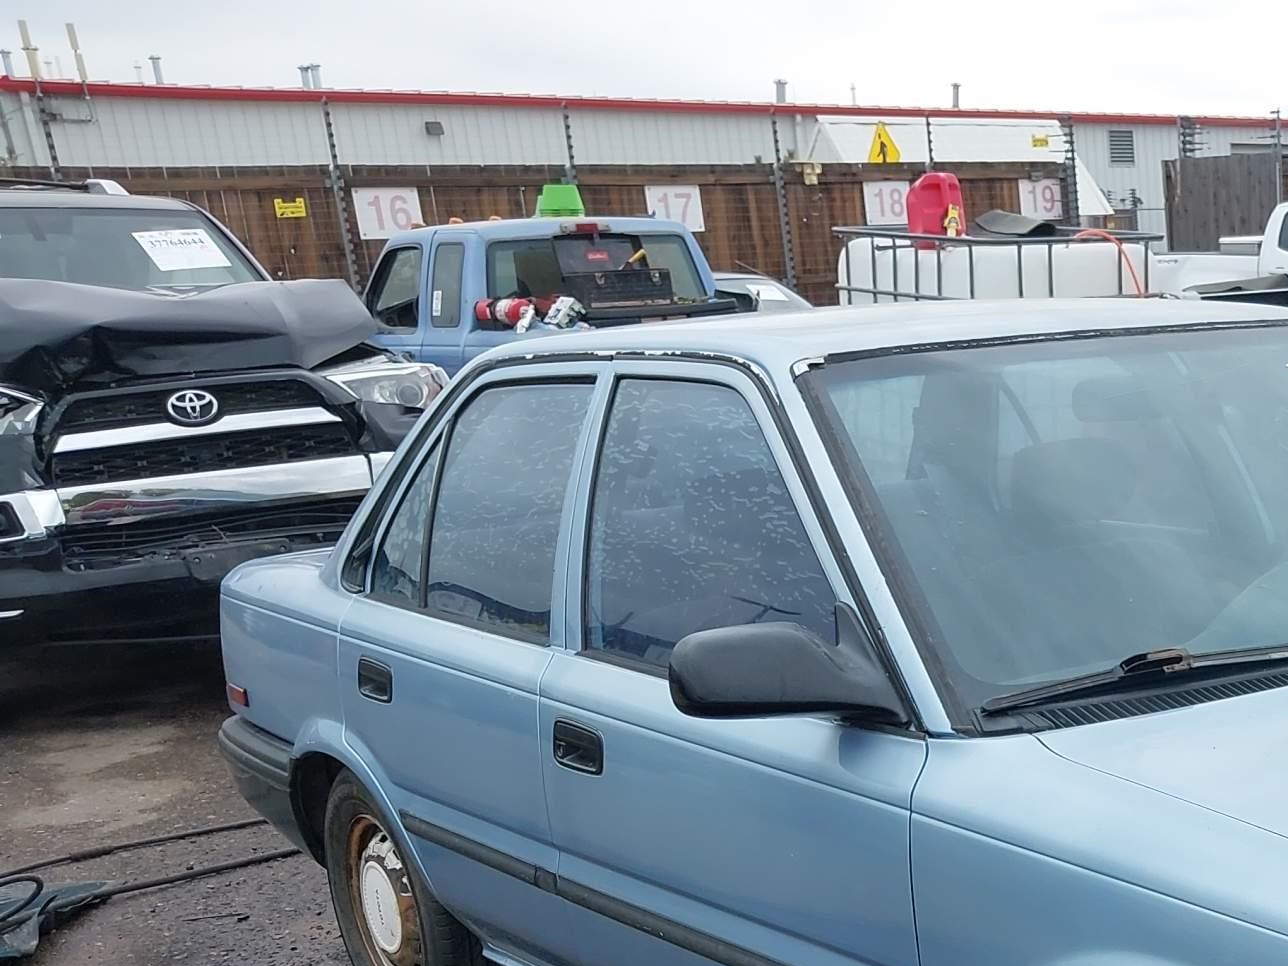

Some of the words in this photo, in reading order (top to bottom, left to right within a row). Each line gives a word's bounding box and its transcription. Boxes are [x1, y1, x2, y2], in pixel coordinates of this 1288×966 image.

[367, 194, 412, 231] 16
[656, 192, 692, 224] 17
[873, 187, 904, 217] 18
[1028, 184, 1055, 213] 19
